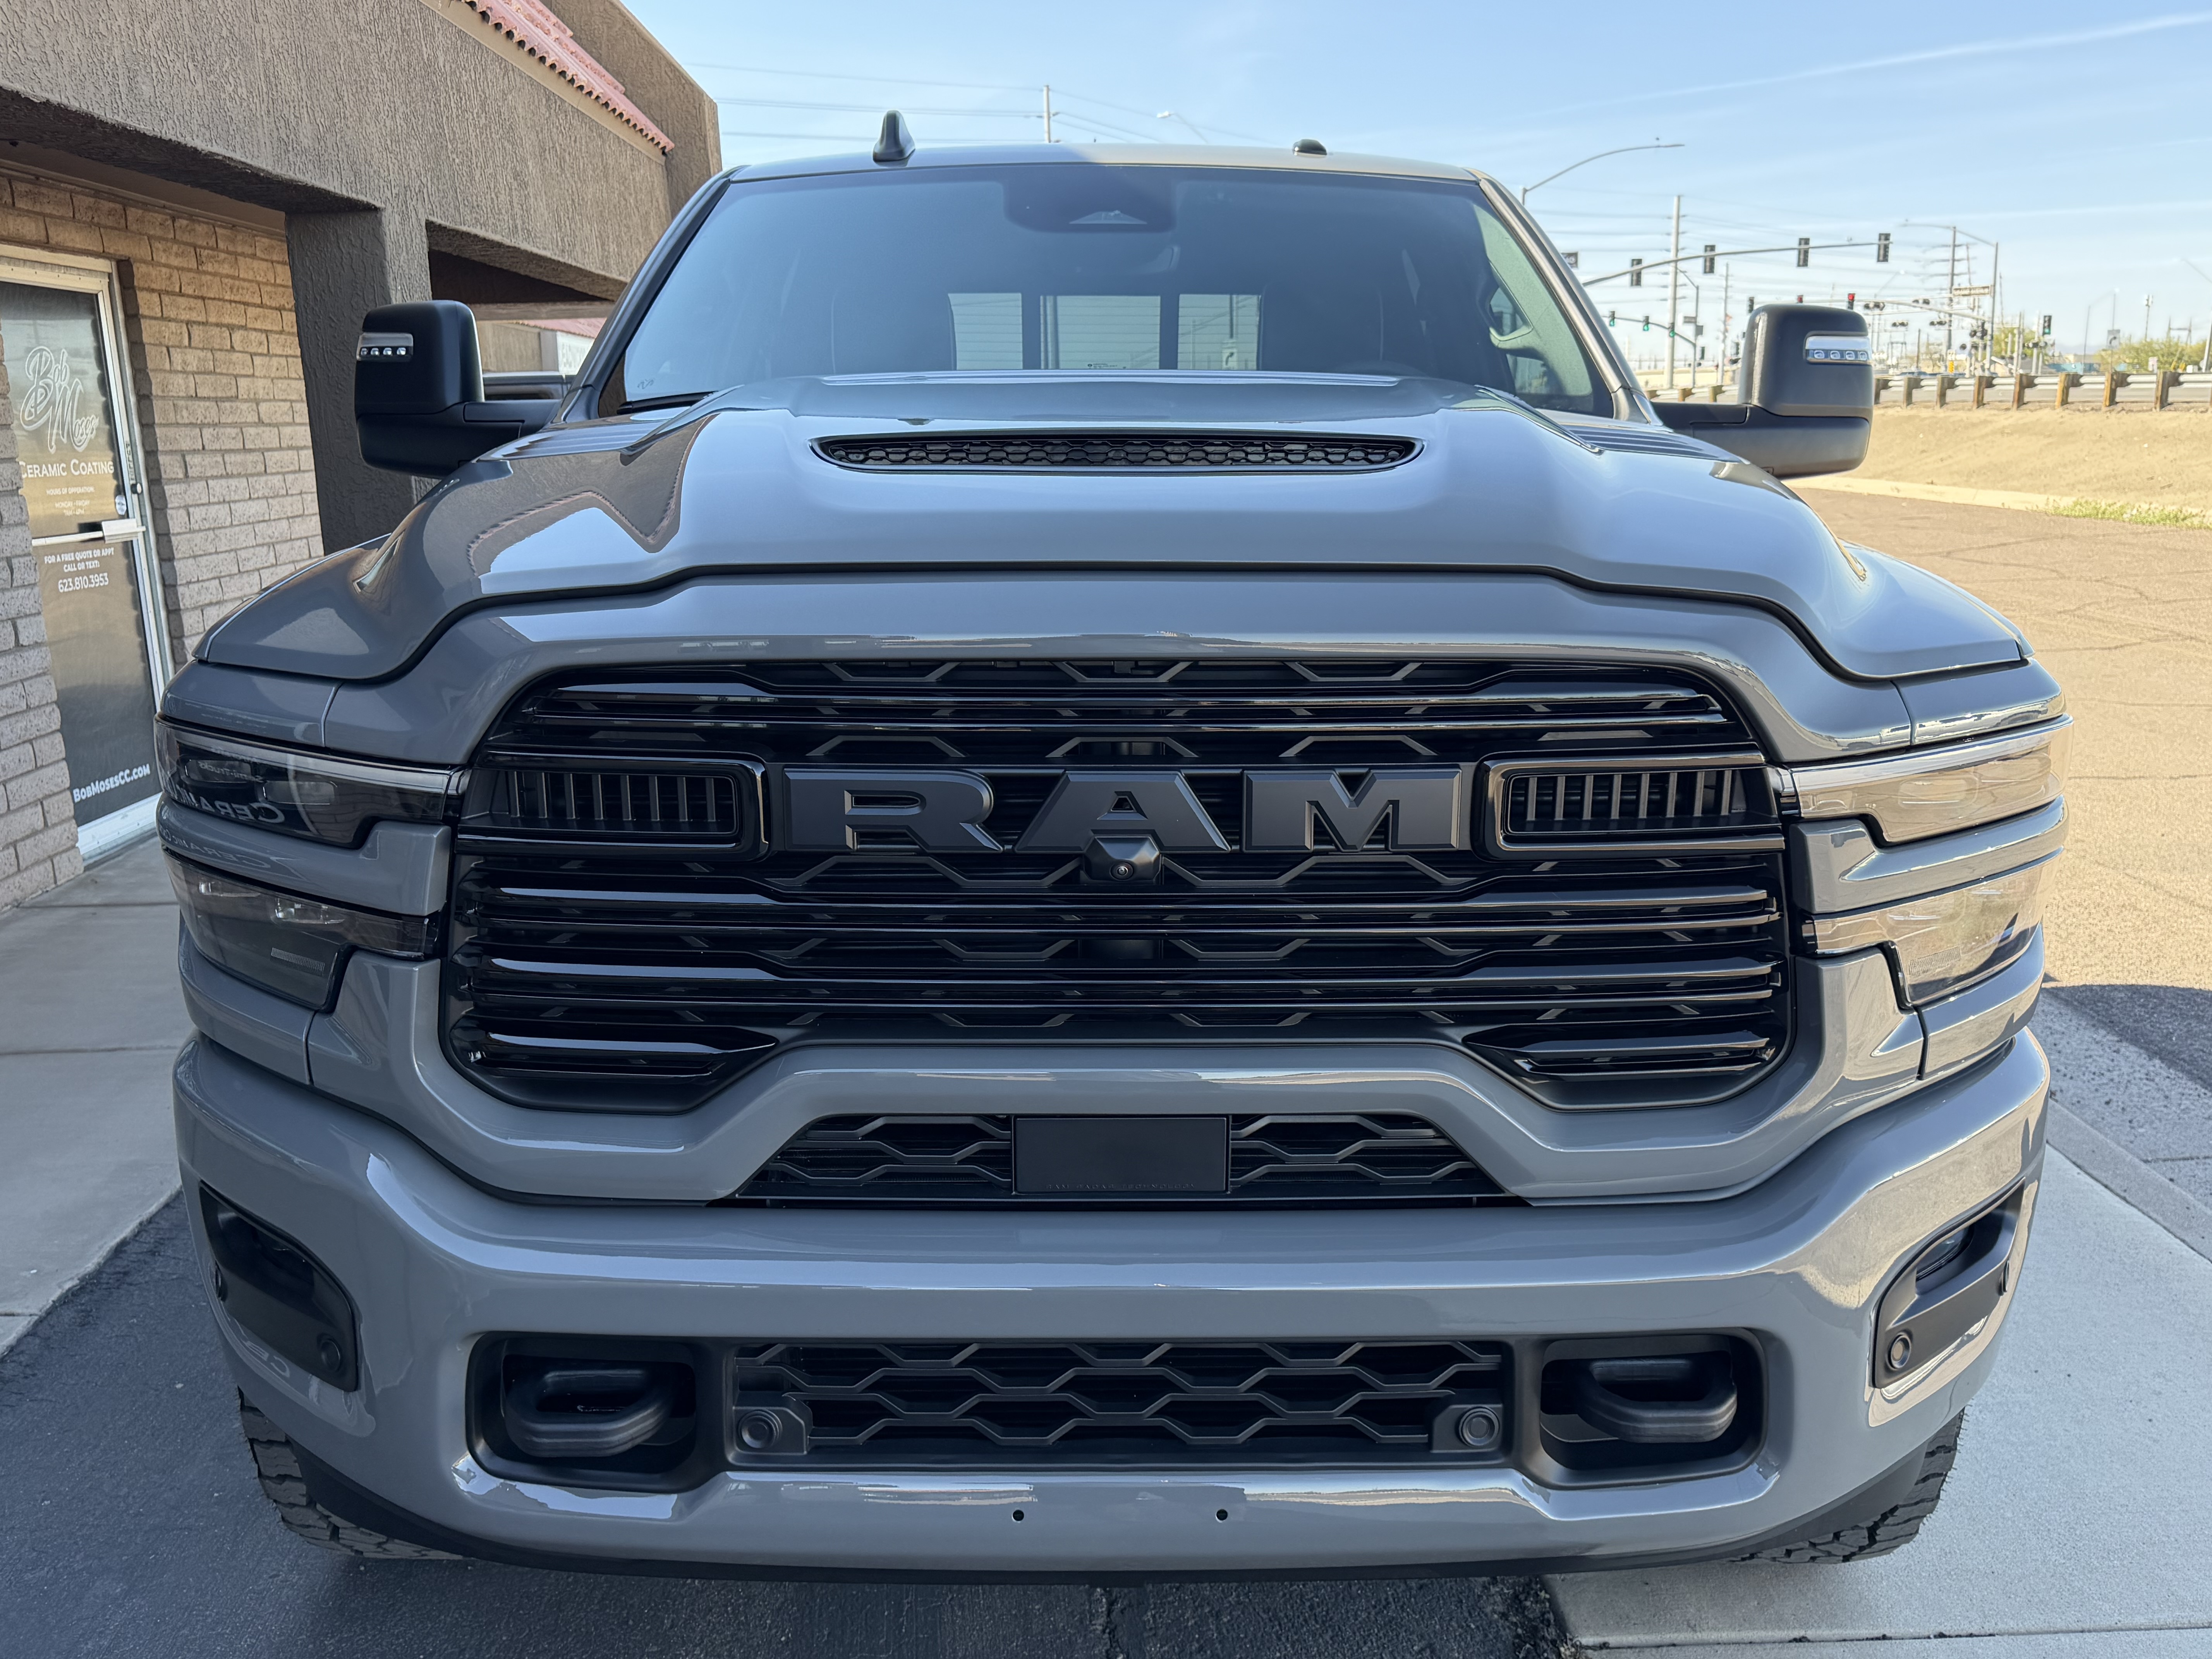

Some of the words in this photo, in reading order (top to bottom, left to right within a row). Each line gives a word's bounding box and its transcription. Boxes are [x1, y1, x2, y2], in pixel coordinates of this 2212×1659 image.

[48, 378, 99, 454] Moses
[70, 459, 115, 475] COATING
[45, 555, 56, 564] FOR
[57, 554, 61, 562] A
[61, 553, 75, 562] FREE
[75, 550, 93, 561] QUOTE
[93, 549, 101, 557] OR
[101, 547, 114, 556] APPT
[64, 563, 77, 572] CALL
[77, 562, 85, 570] OR
[58, 572, 109, 592] 623.810.3953
[784, 767, 1461, 852] RAM
